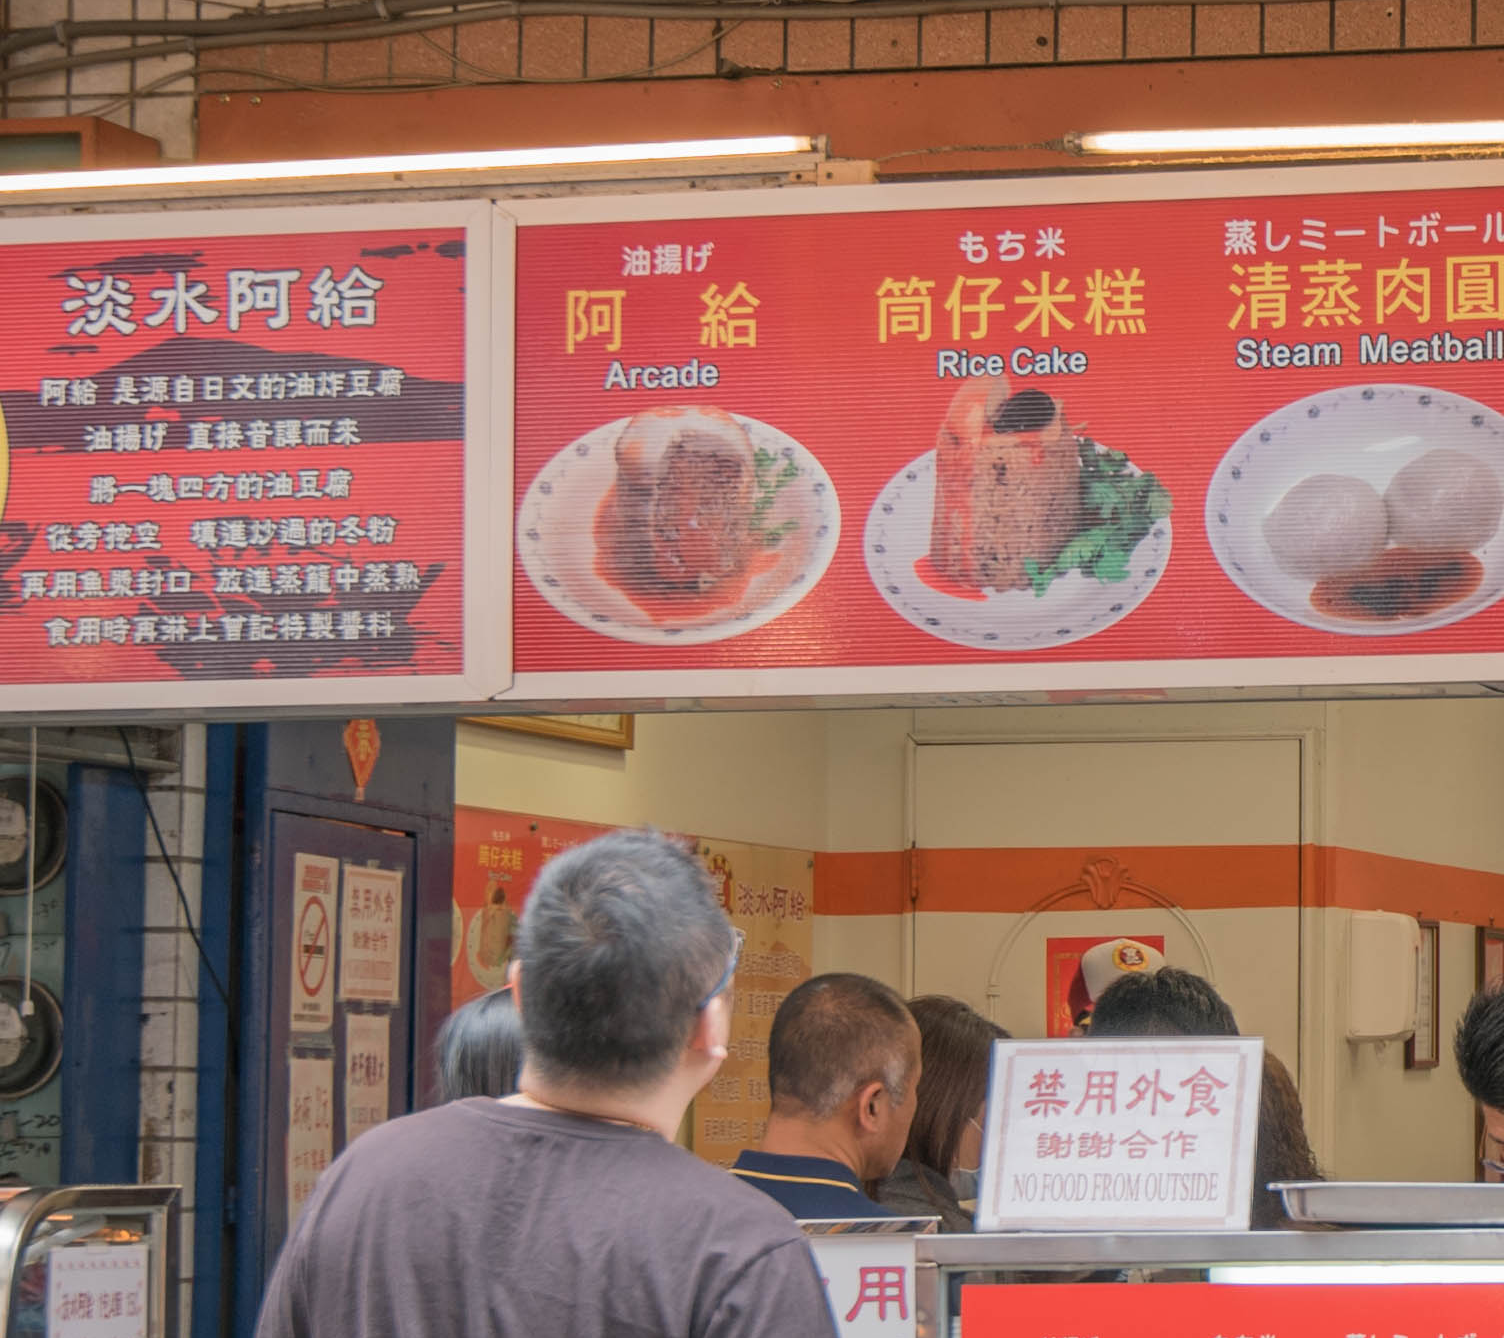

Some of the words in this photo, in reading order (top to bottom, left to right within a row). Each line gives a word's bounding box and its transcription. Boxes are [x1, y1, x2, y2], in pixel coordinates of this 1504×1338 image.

[621, 242, 716, 278] 油揚げ
[959, 227, 1066, 265] もち米
[61, 267, 386, 339] 淡水阿給
[565, 281, 761, 355] 阿給
[876, 268, 1148, 344] 筒仔米糕
[937, 350, 1005, 378] Rice
[1011, 346, 1088, 376] Cake
[1236, 338, 1343, 370] Steam
[1359, 331, 1504, 365] Meatball
[39, 378, 99, 407] 阿給
[113, 368, 404, 405] 是源自日文的油炸豆腐
[603, 359, 720, 391] Arcade
[83, 421, 169, 453] 油揚げ
[89, 467, 354, 504] 將一塊四方的油豆腐
[190, 514, 399, 550] 填進炒過的冬粉
[1024, 1066, 1229, 1118] 禁用外食
[1036, 1129, 1198, 1160] 謝謝合作
[1011, 1173, 1038, 1202] NO
[1042, 1173, 1094, 1202] FOOD
[1095, 1172, 1141, 1201] FROM
[1143, 1172, 1219, 1202] OUTSIDE
